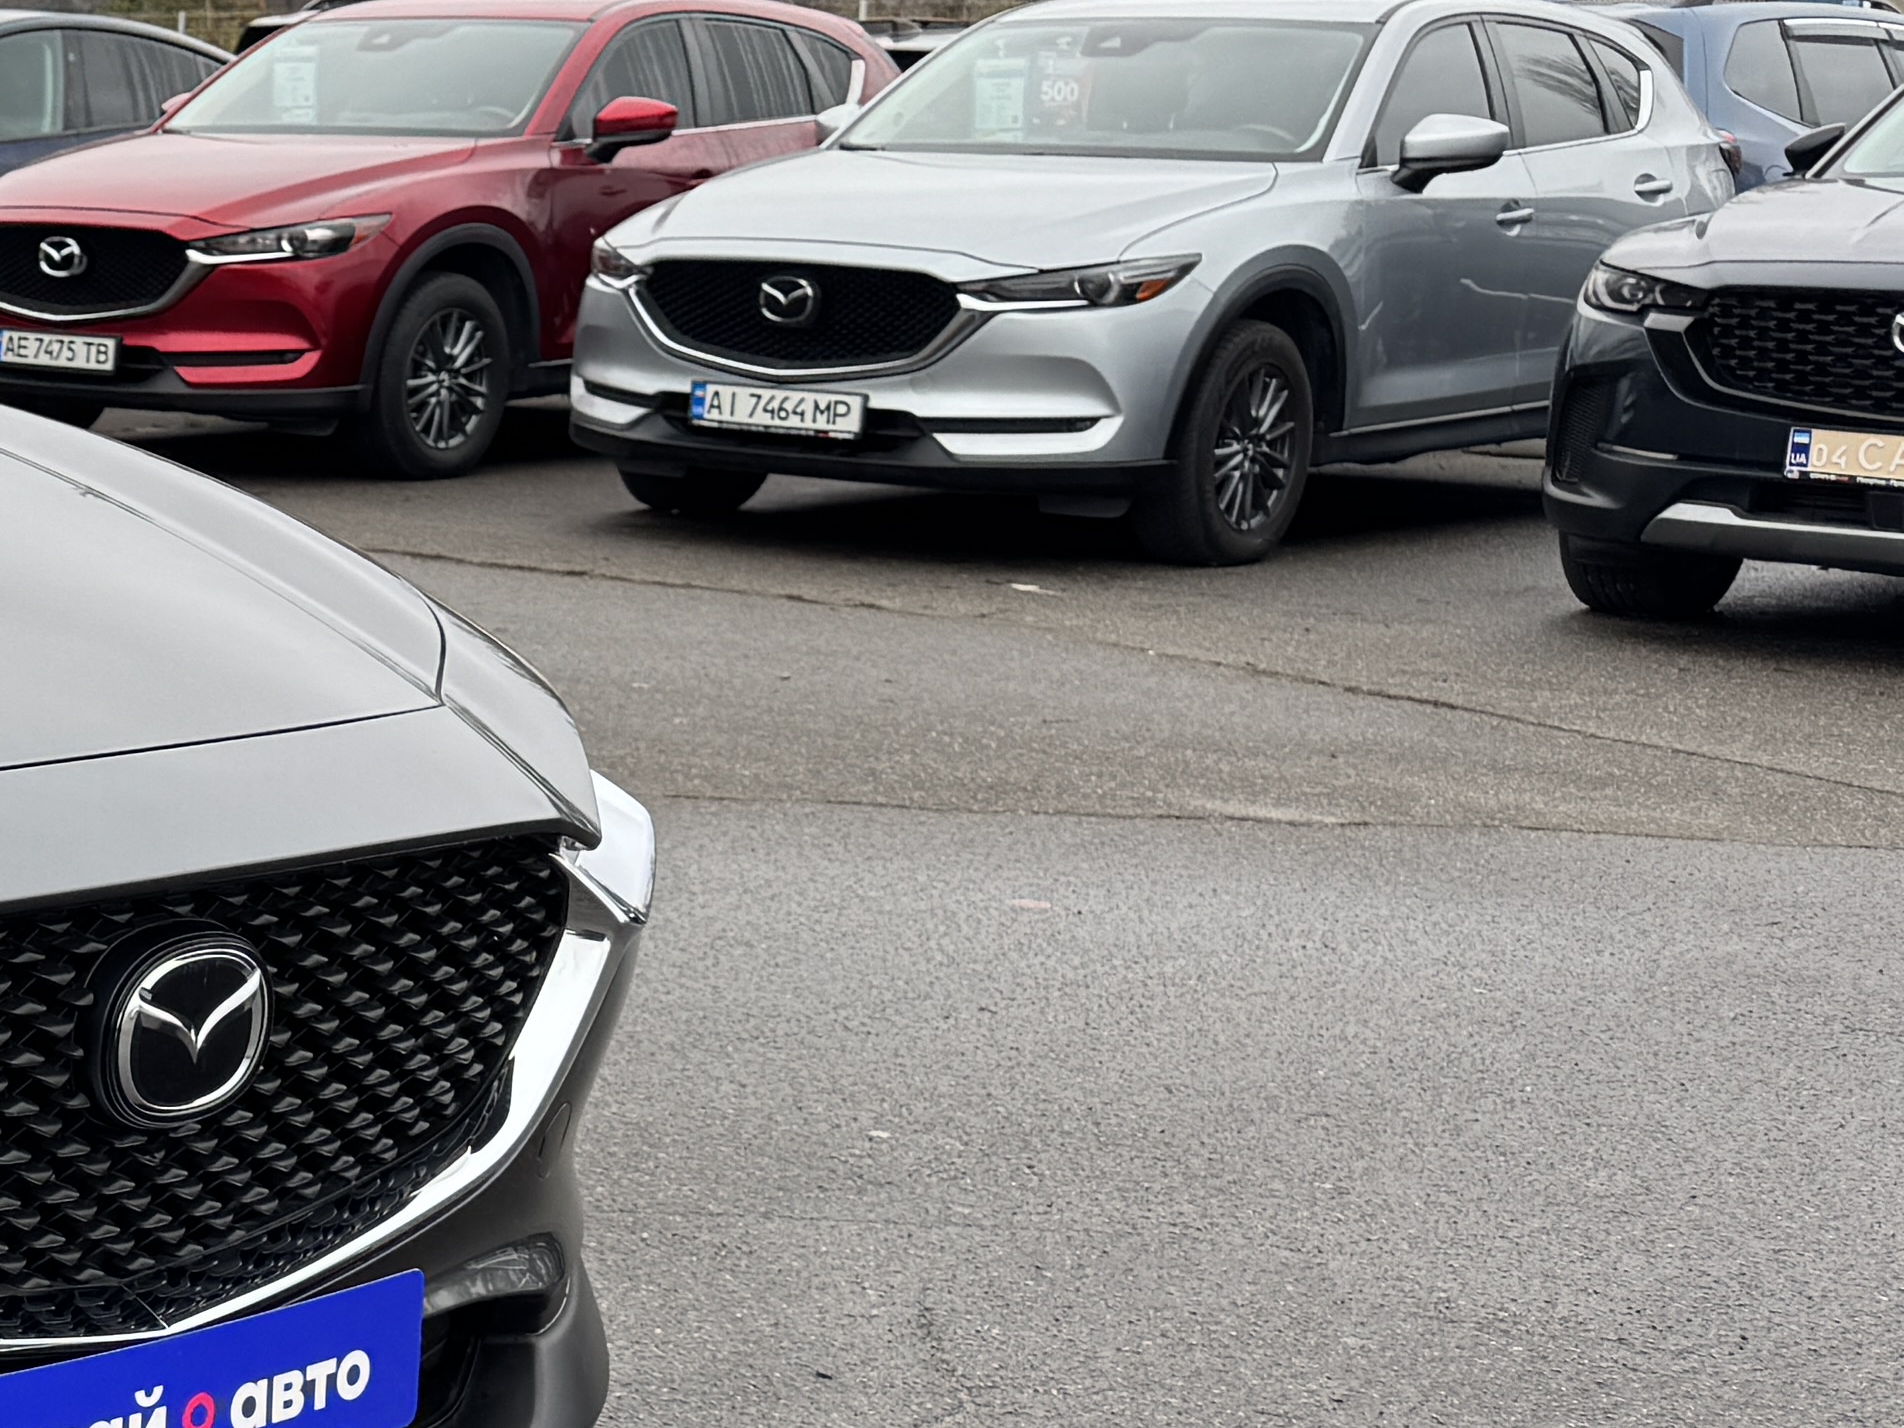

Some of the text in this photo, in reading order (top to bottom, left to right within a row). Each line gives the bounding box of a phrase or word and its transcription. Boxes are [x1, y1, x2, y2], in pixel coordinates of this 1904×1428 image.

[1040, 79, 1079, 102] 500
[4, 334, 30, 359] AE
[32, 337, 77, 363] 7475
[82, 341, 110, 365] TB
[707, 390, 735, 417] AI
[748, 392, 807, 424] 7464
[812, 398, 852, 426] MP
[1812, 443, 1848, 470] 04
